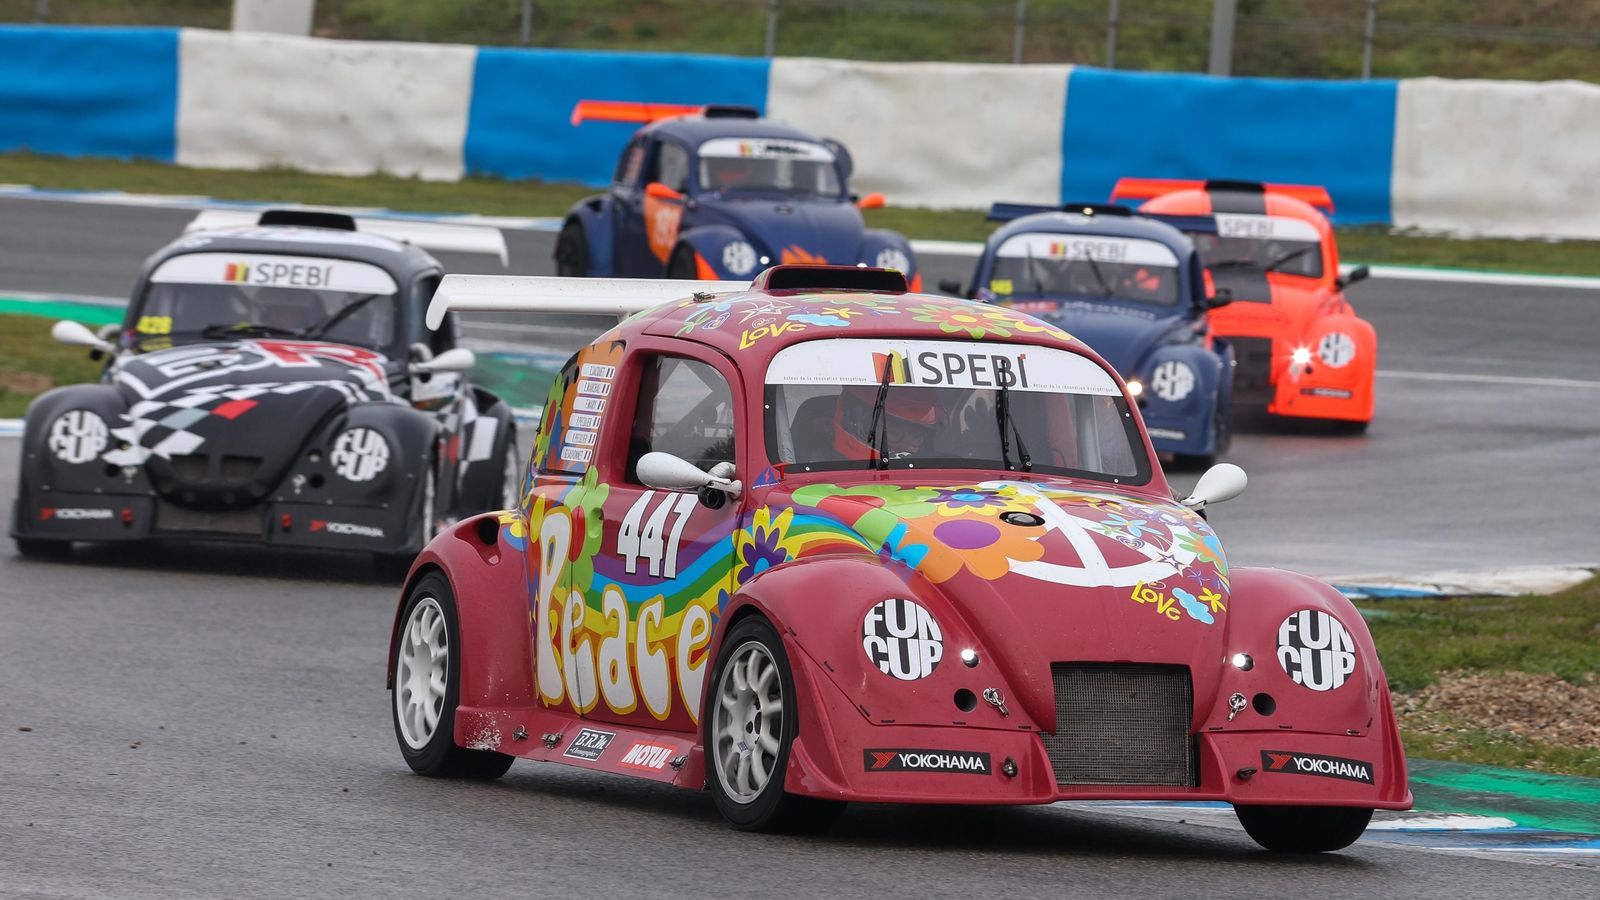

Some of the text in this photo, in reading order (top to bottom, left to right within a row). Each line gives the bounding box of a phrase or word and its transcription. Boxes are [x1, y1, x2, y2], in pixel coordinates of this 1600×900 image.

[51, 410, 108, 438] FUN
[49, 435, 107, 463] CUP
[332, 427, 389, 456] FUN
[331, 449, 387, 481] CUP
[617, 490, 699, 580] 447
[864, 599, 943, 641] FUN
[1278, 609, 1355, 653] FUN
[863, 635, 943, 681] CUP
[1277, 645, 1356, 691] CUP
[621, 743, 673, 769] MOTUL
[899, 753, 985, 771] YOKOHAMA
[1294, 756, 1369, 780] YOKOHAMA
